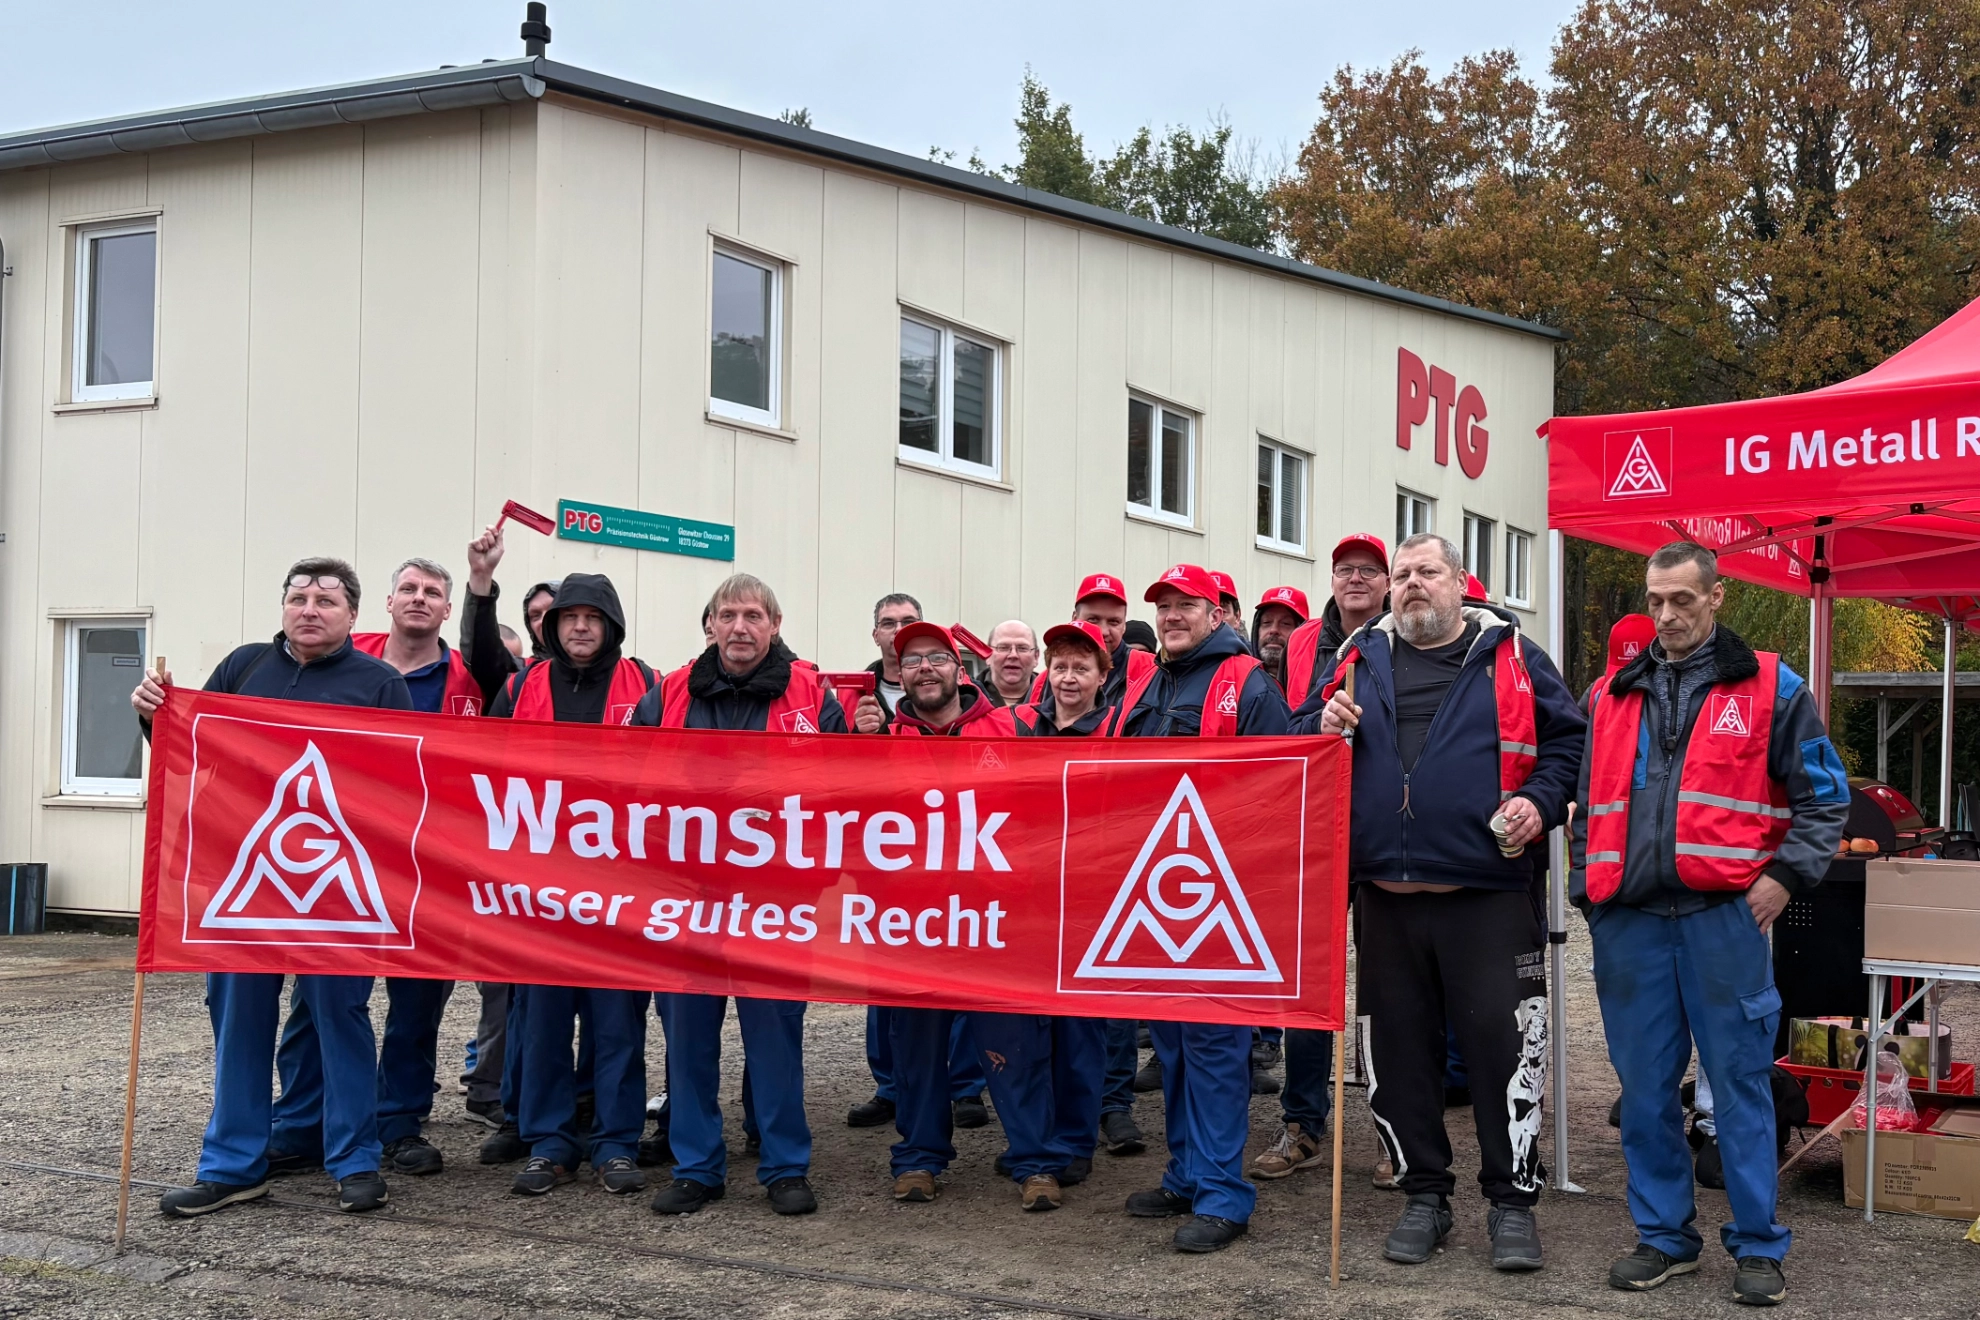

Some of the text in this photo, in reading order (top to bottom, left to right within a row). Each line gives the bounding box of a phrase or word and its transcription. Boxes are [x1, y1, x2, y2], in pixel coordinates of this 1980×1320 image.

[1396, 346, 1489, 480] PTG
[1725, 435, 1770, 475] IG
[1787, 417, 1940, 471] Metall
[564, 508, 603, 534] PTG
[606, 527, 649, 540] Präzisionstechnik
[470, 773, 1013, 872] Warnstreik
[467, 881, 1007, 949] unser gutes Recht
